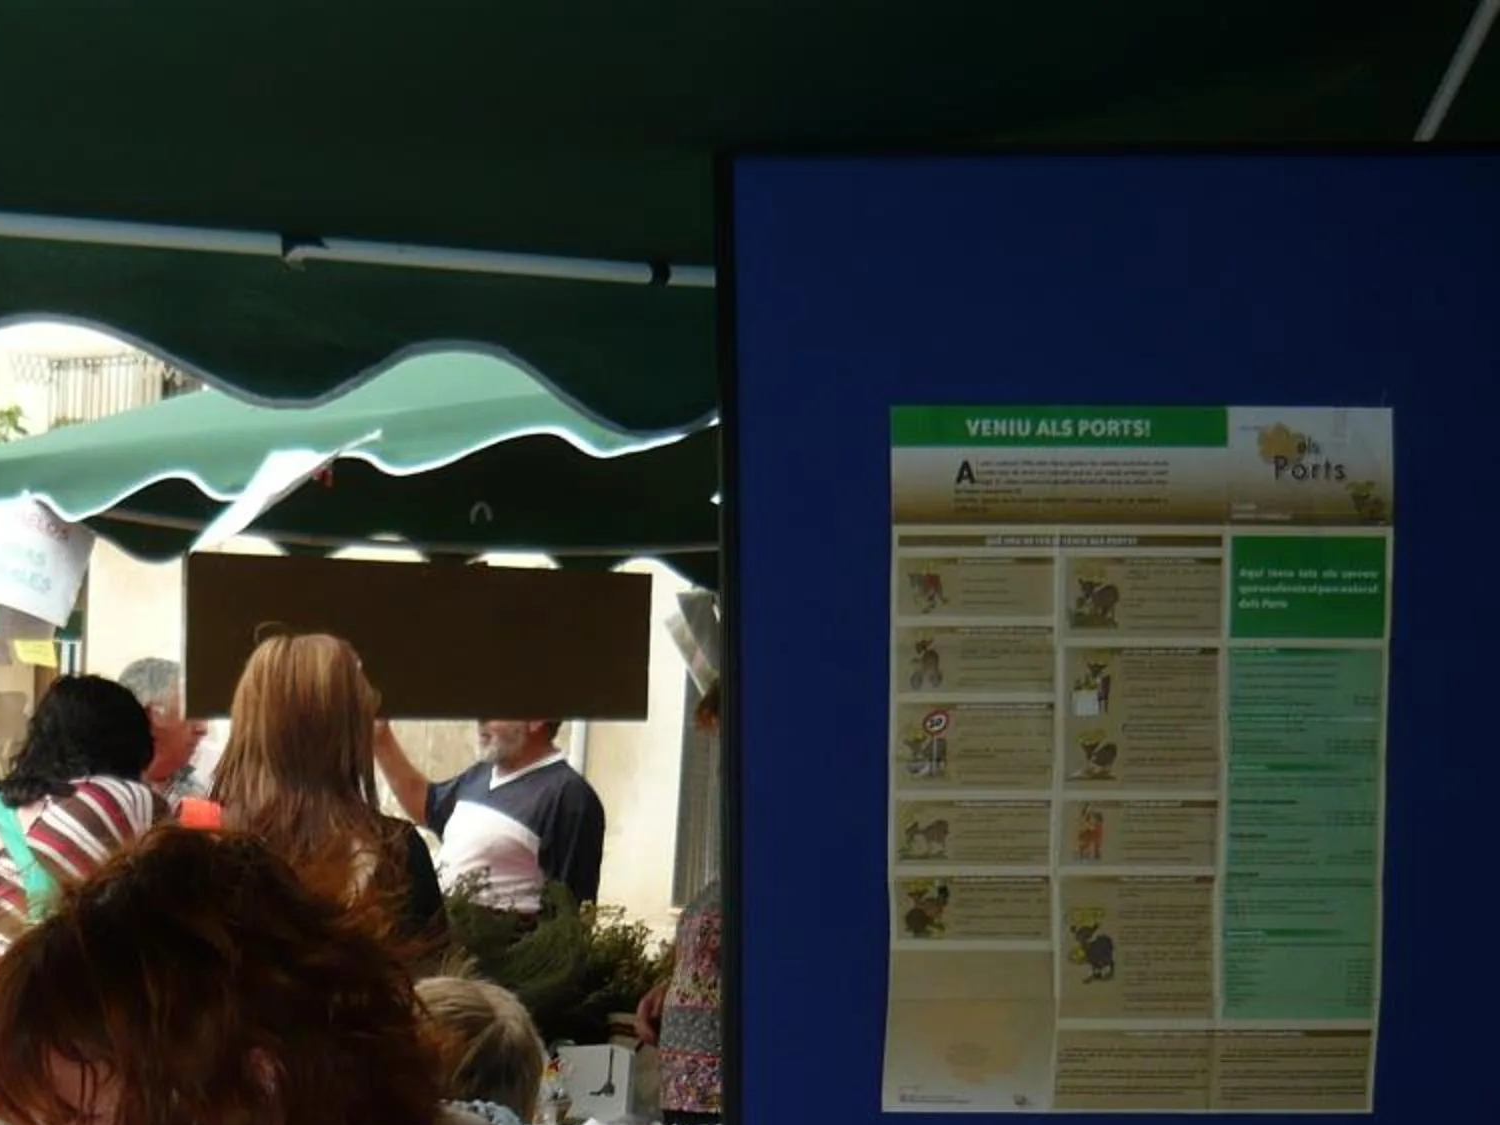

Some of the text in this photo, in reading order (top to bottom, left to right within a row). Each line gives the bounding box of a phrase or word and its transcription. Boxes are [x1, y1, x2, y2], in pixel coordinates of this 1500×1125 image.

[965, 417, 1152, 438] VENIU ALS PORTS!
[1274, 455, 1348, 481] Ports
